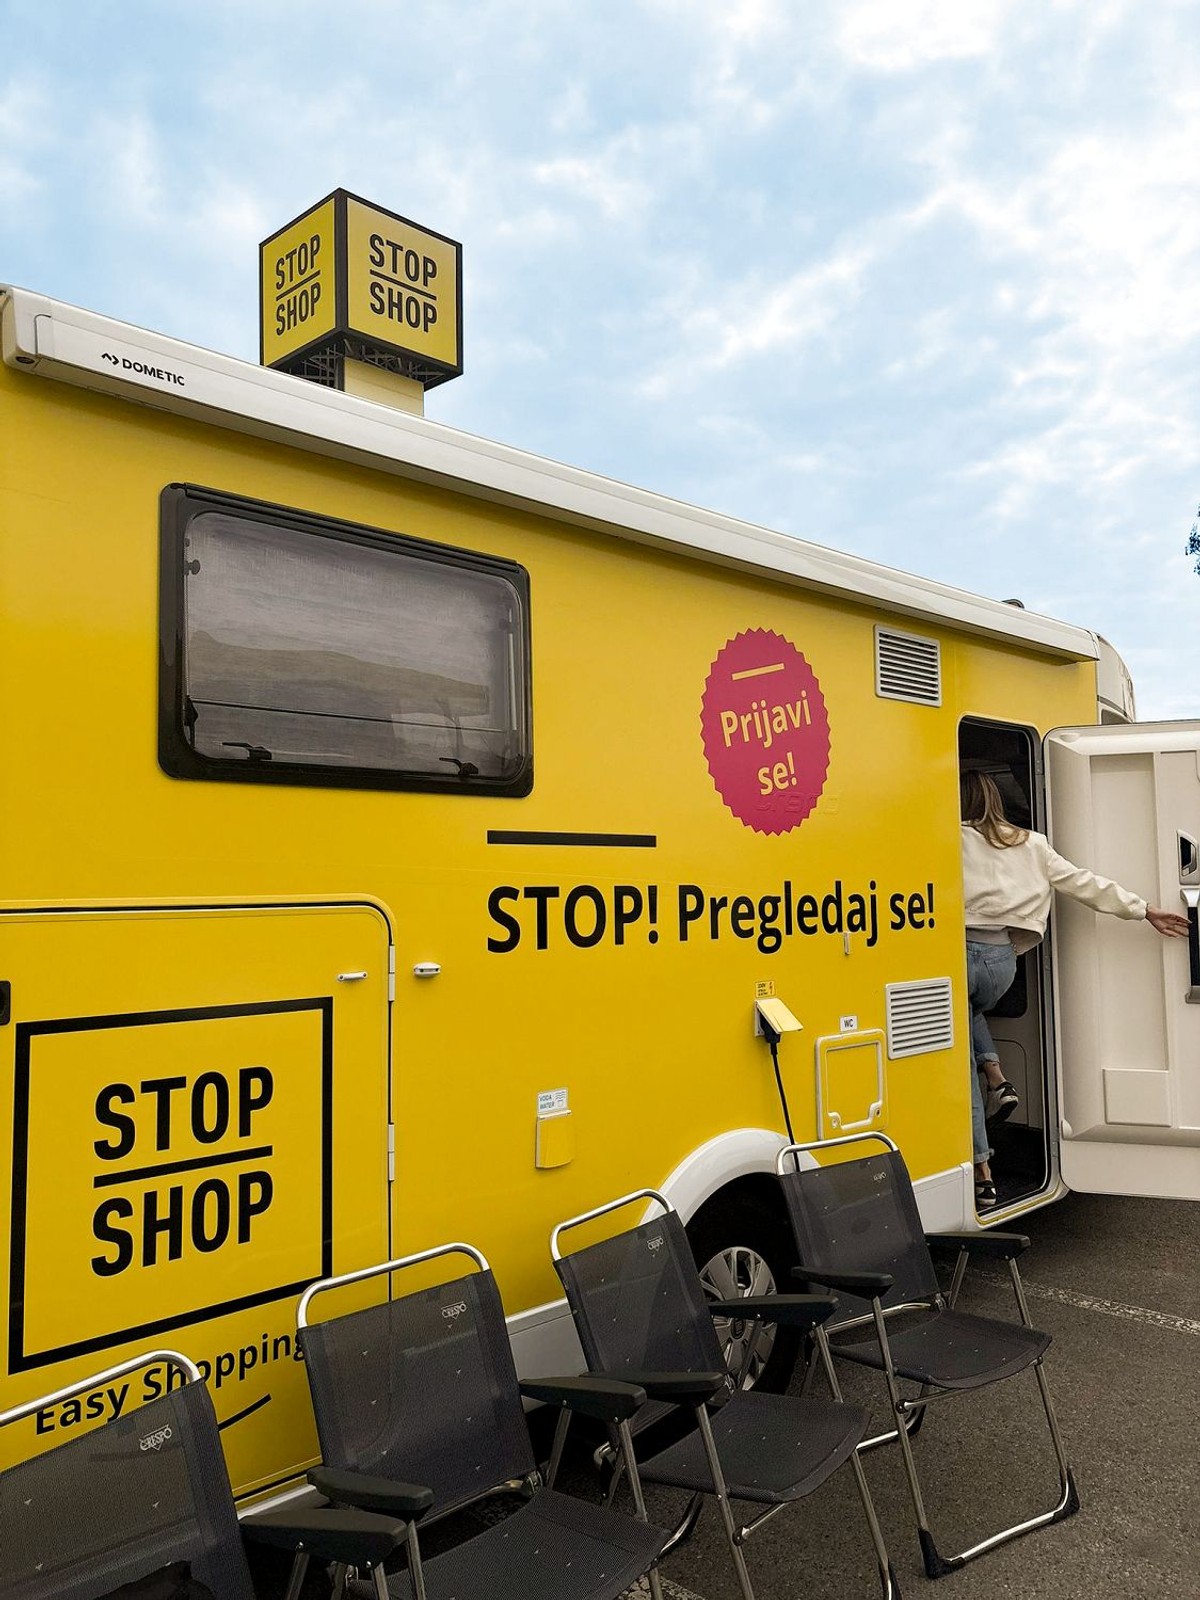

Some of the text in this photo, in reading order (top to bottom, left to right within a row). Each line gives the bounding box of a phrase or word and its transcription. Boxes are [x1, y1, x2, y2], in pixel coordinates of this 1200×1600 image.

[275, 233, 321, 290] STOP
[369, 233, 438, 287] STOP
[275, 281, 321, 336] SHOP
[369, 281, 438, 333] SHOP
[121, 358, 185, 386] DOMETIC
[719, 690, 812, 748] Prijavi
[757, 751, 798, 795] se!
[487, 880, 936, 954] STOP! Pregledaj se!
[843, 1018, 854, 1028] WC
[93, 1066, 274, 1161] STOP
[91, 1170, 274, 1277] SHOP
[36, 1383, 130, 1435] Easy
